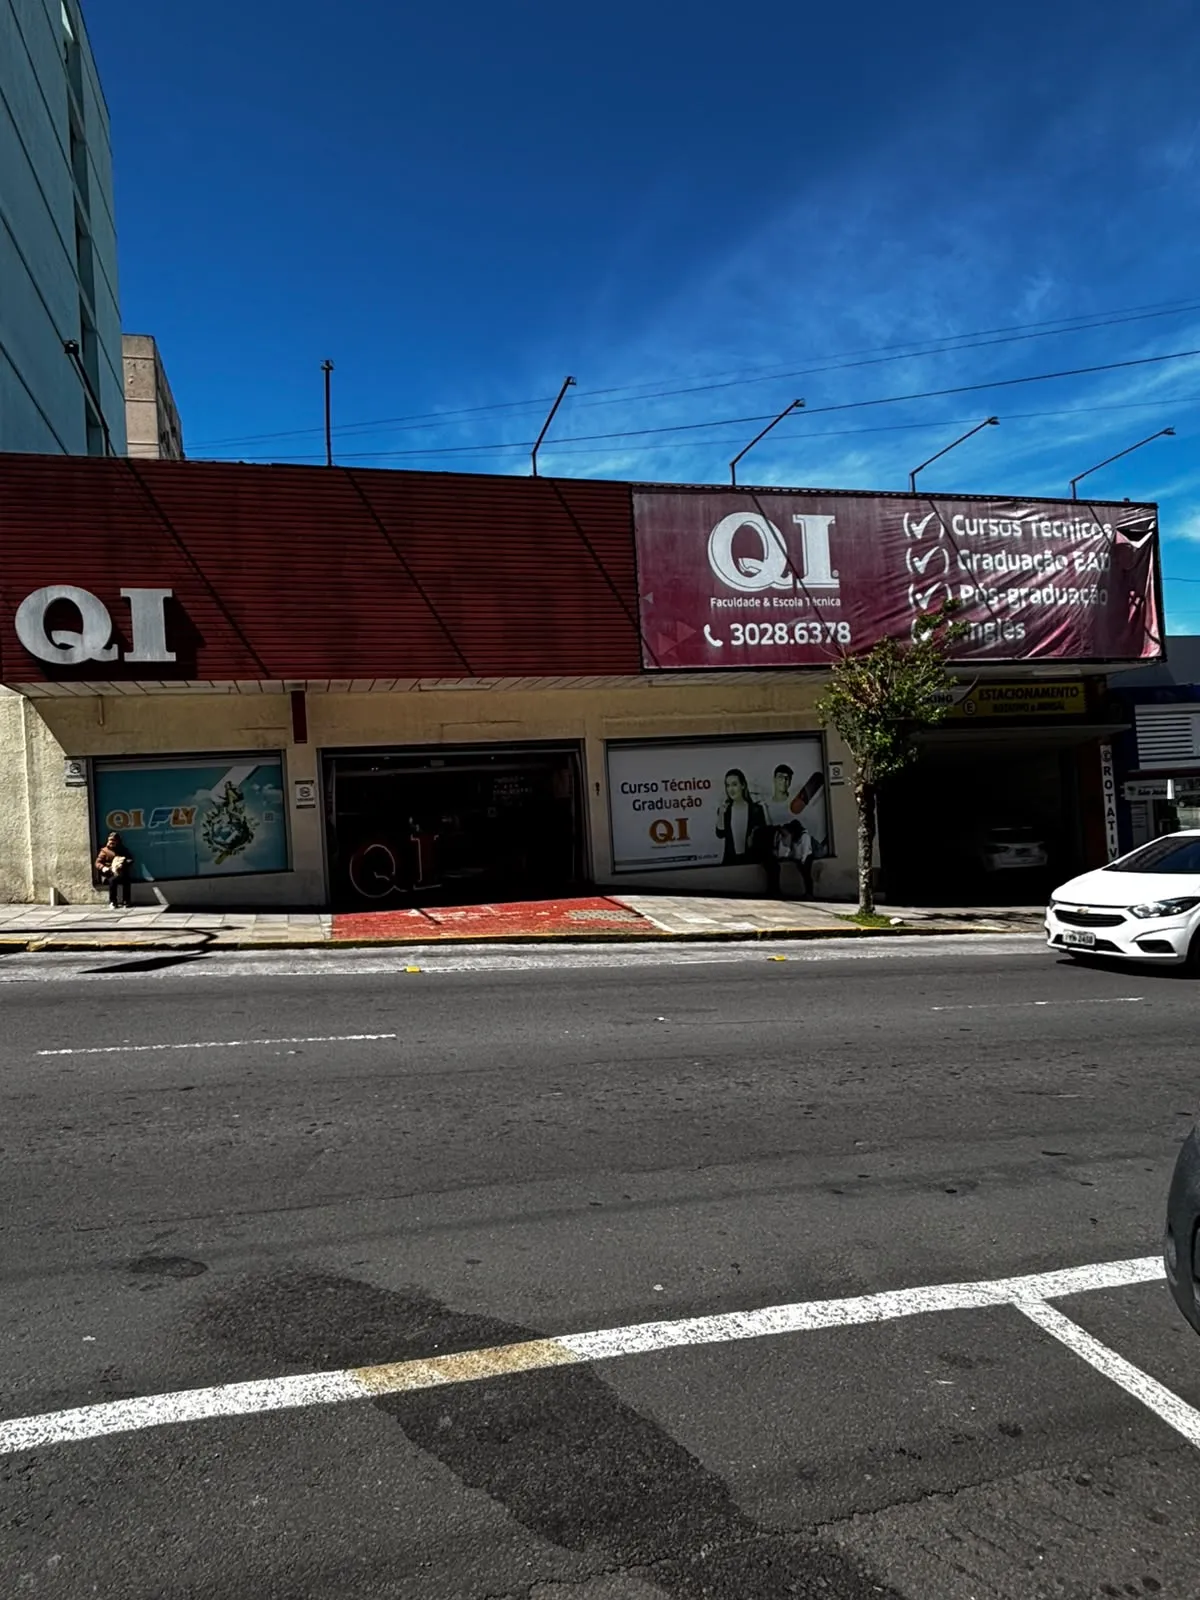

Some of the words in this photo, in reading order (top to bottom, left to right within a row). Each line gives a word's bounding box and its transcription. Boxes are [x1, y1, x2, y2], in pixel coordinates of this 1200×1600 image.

[952, 514, 1022, 538] Cursos
[708, 512, 840, 592] QI
[957, 549, 1068, 576] Graduação
[710, 597, 760, 608] Faculdade
[763, 597, 770, 607] &
[773, 597, 803, 608] Escola
[960, 583, 1108, 610] Pós-graduação
[15, 585, 176, 665] QI
[730, 622, 851, 645] 3028.6378
[978, 686, 1079, 700] ESTACIONAMENTO
[621, 782, 659, 794] Curso
[662, 777, 711, 791] Técnico
[632, 795, 702, 812] Graduação
[107, 809, 144, 829] QI
[650, 818, 690, 844] QI
